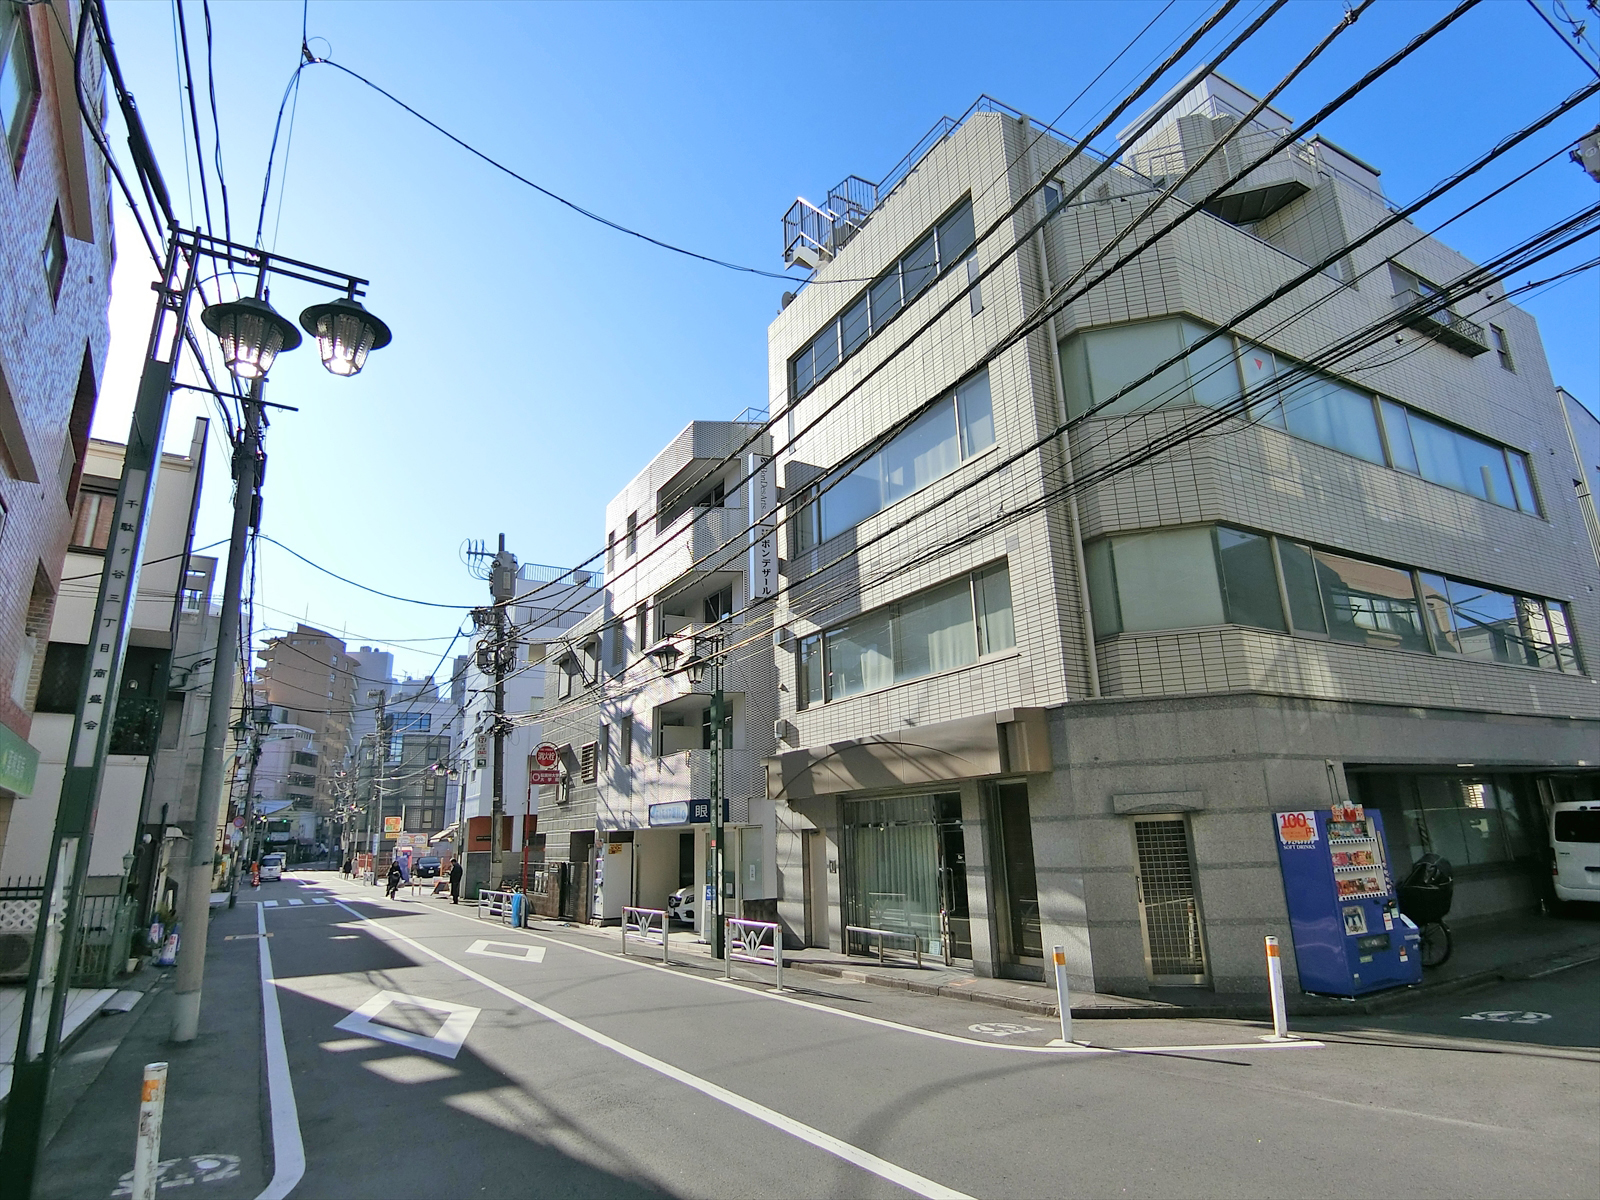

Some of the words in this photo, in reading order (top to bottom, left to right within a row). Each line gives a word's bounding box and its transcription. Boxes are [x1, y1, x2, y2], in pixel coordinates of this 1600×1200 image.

[761, 538, 771, 596] ボンデザール
[83, 499, 139, 730] 千駄ヶ谷三丁目商盛会
[537, 752, 555, 761] 消火栓
